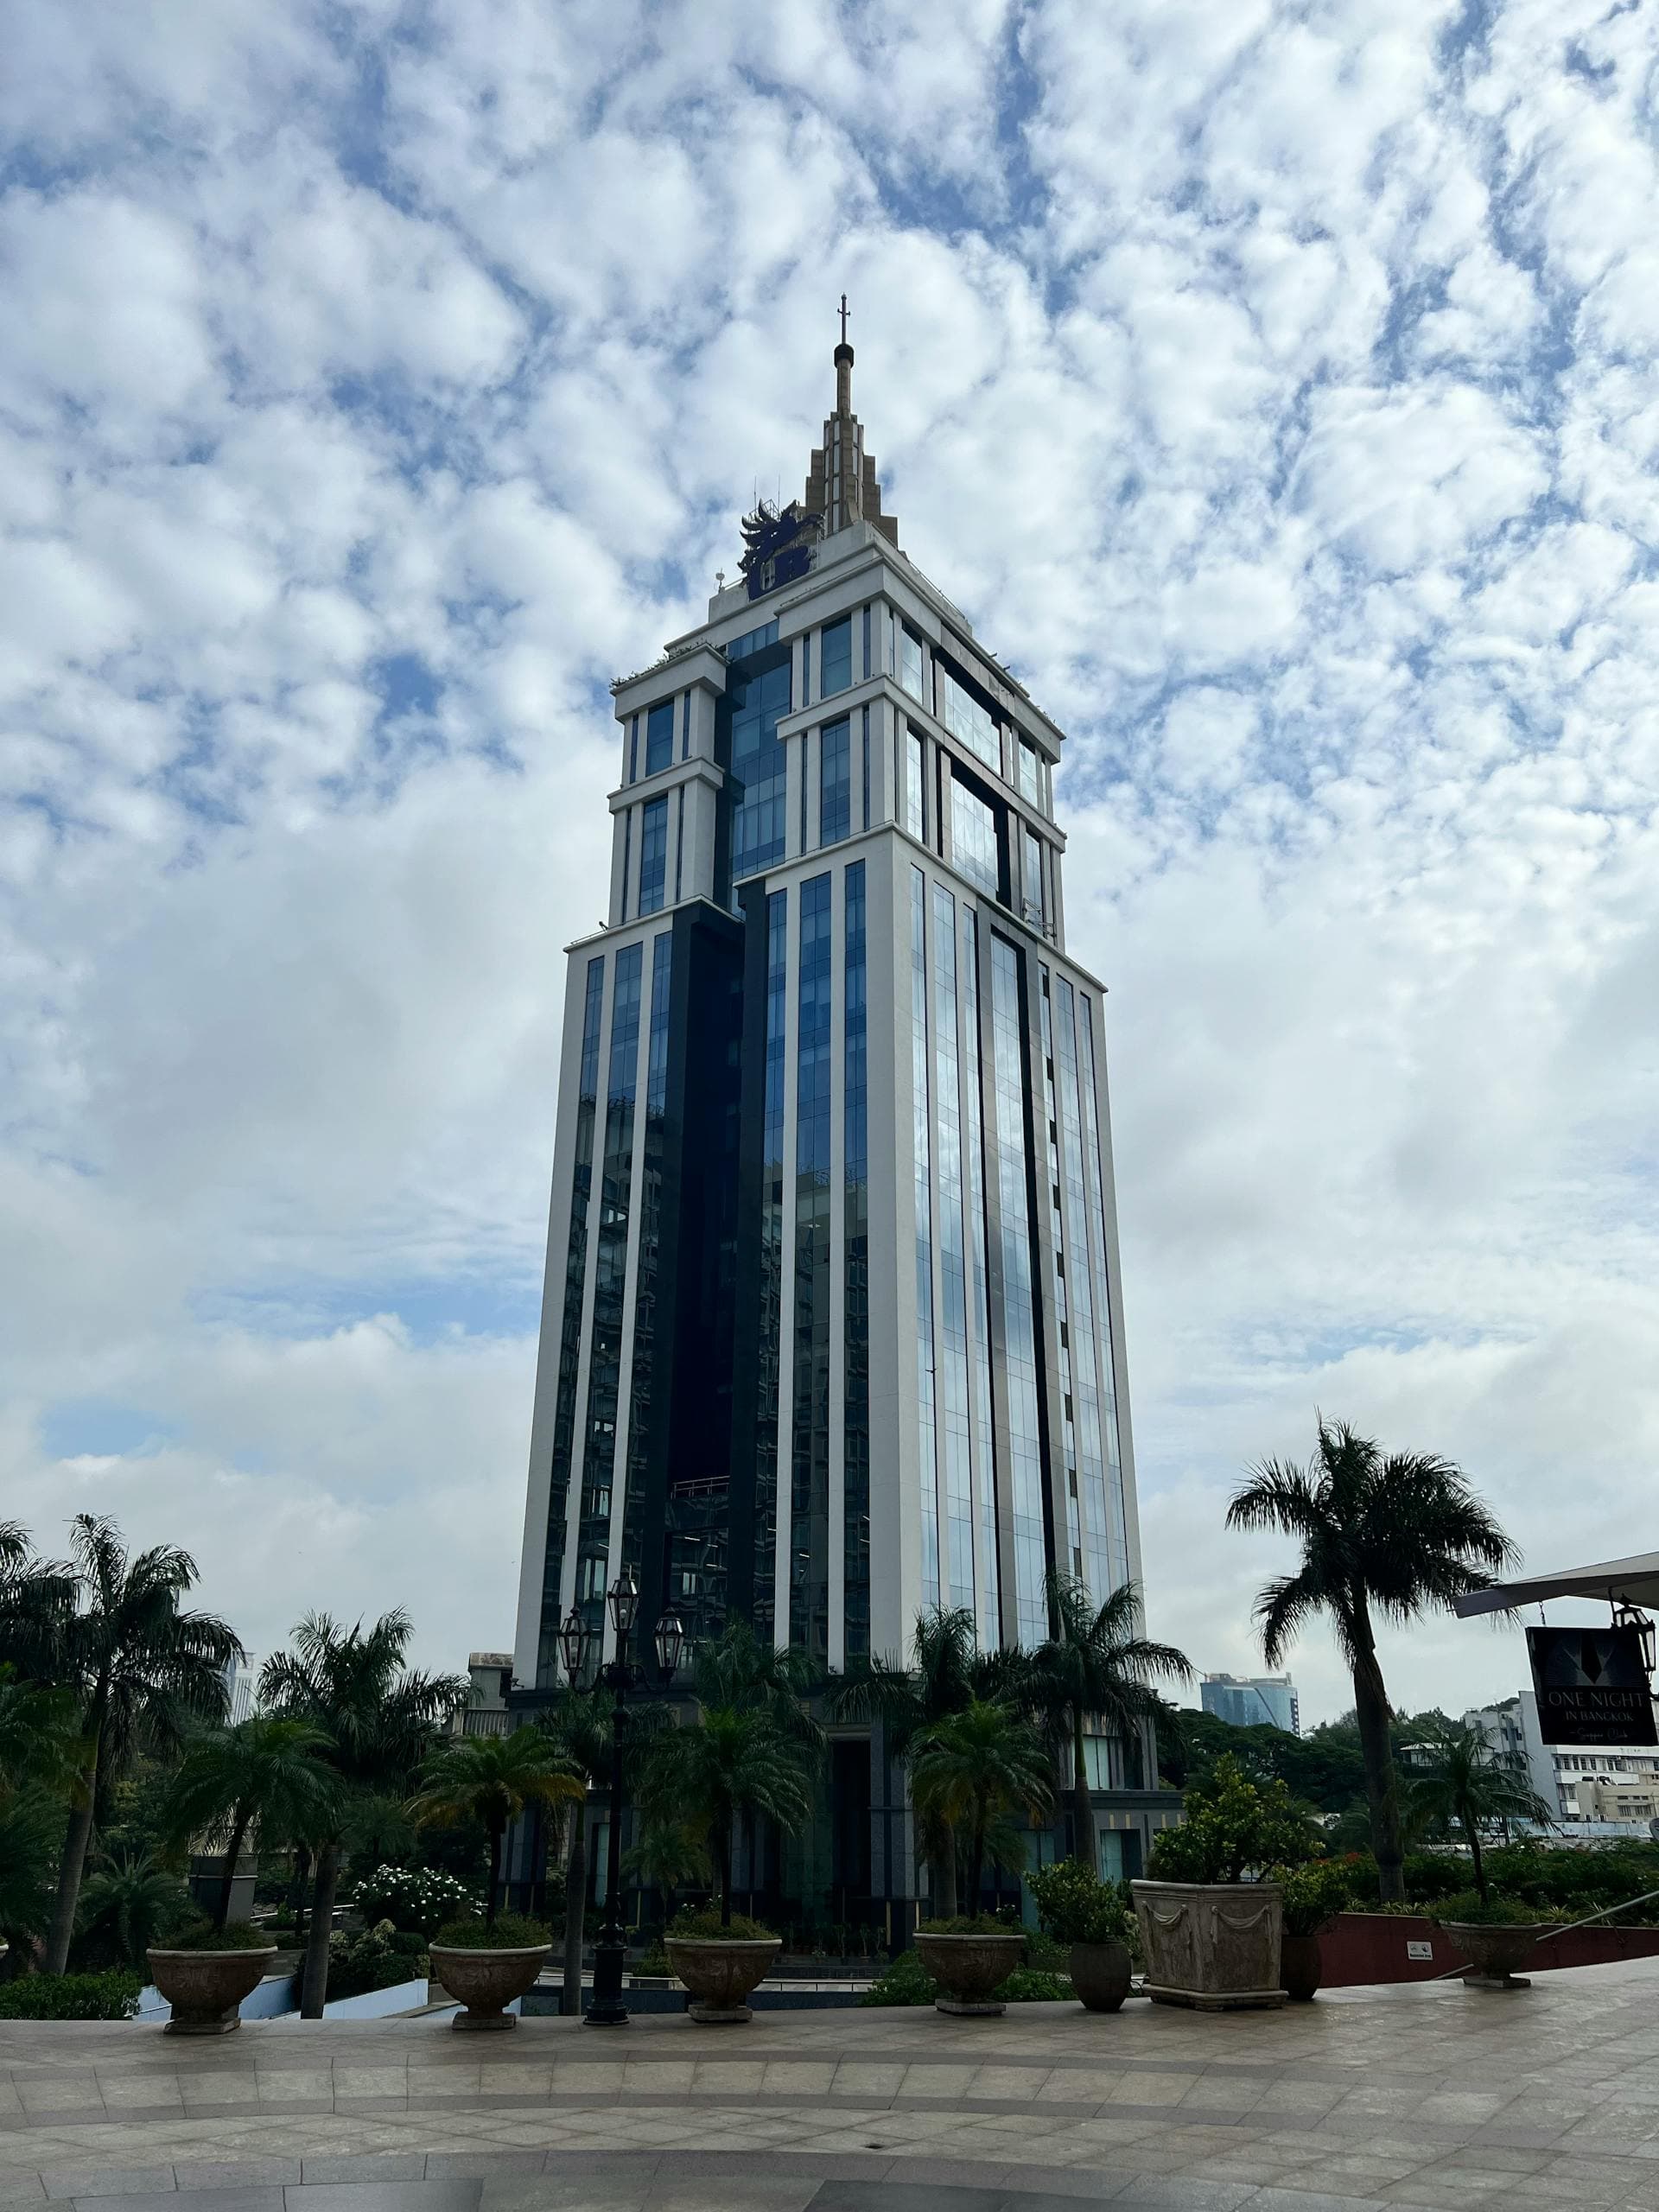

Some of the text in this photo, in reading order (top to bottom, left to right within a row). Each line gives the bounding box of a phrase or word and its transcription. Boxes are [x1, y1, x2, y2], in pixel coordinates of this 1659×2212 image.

[1548, 1691, 1643, 1707] ONE NIGHT
[1565, 1711, 1634, 1721] IN BANGKOK
